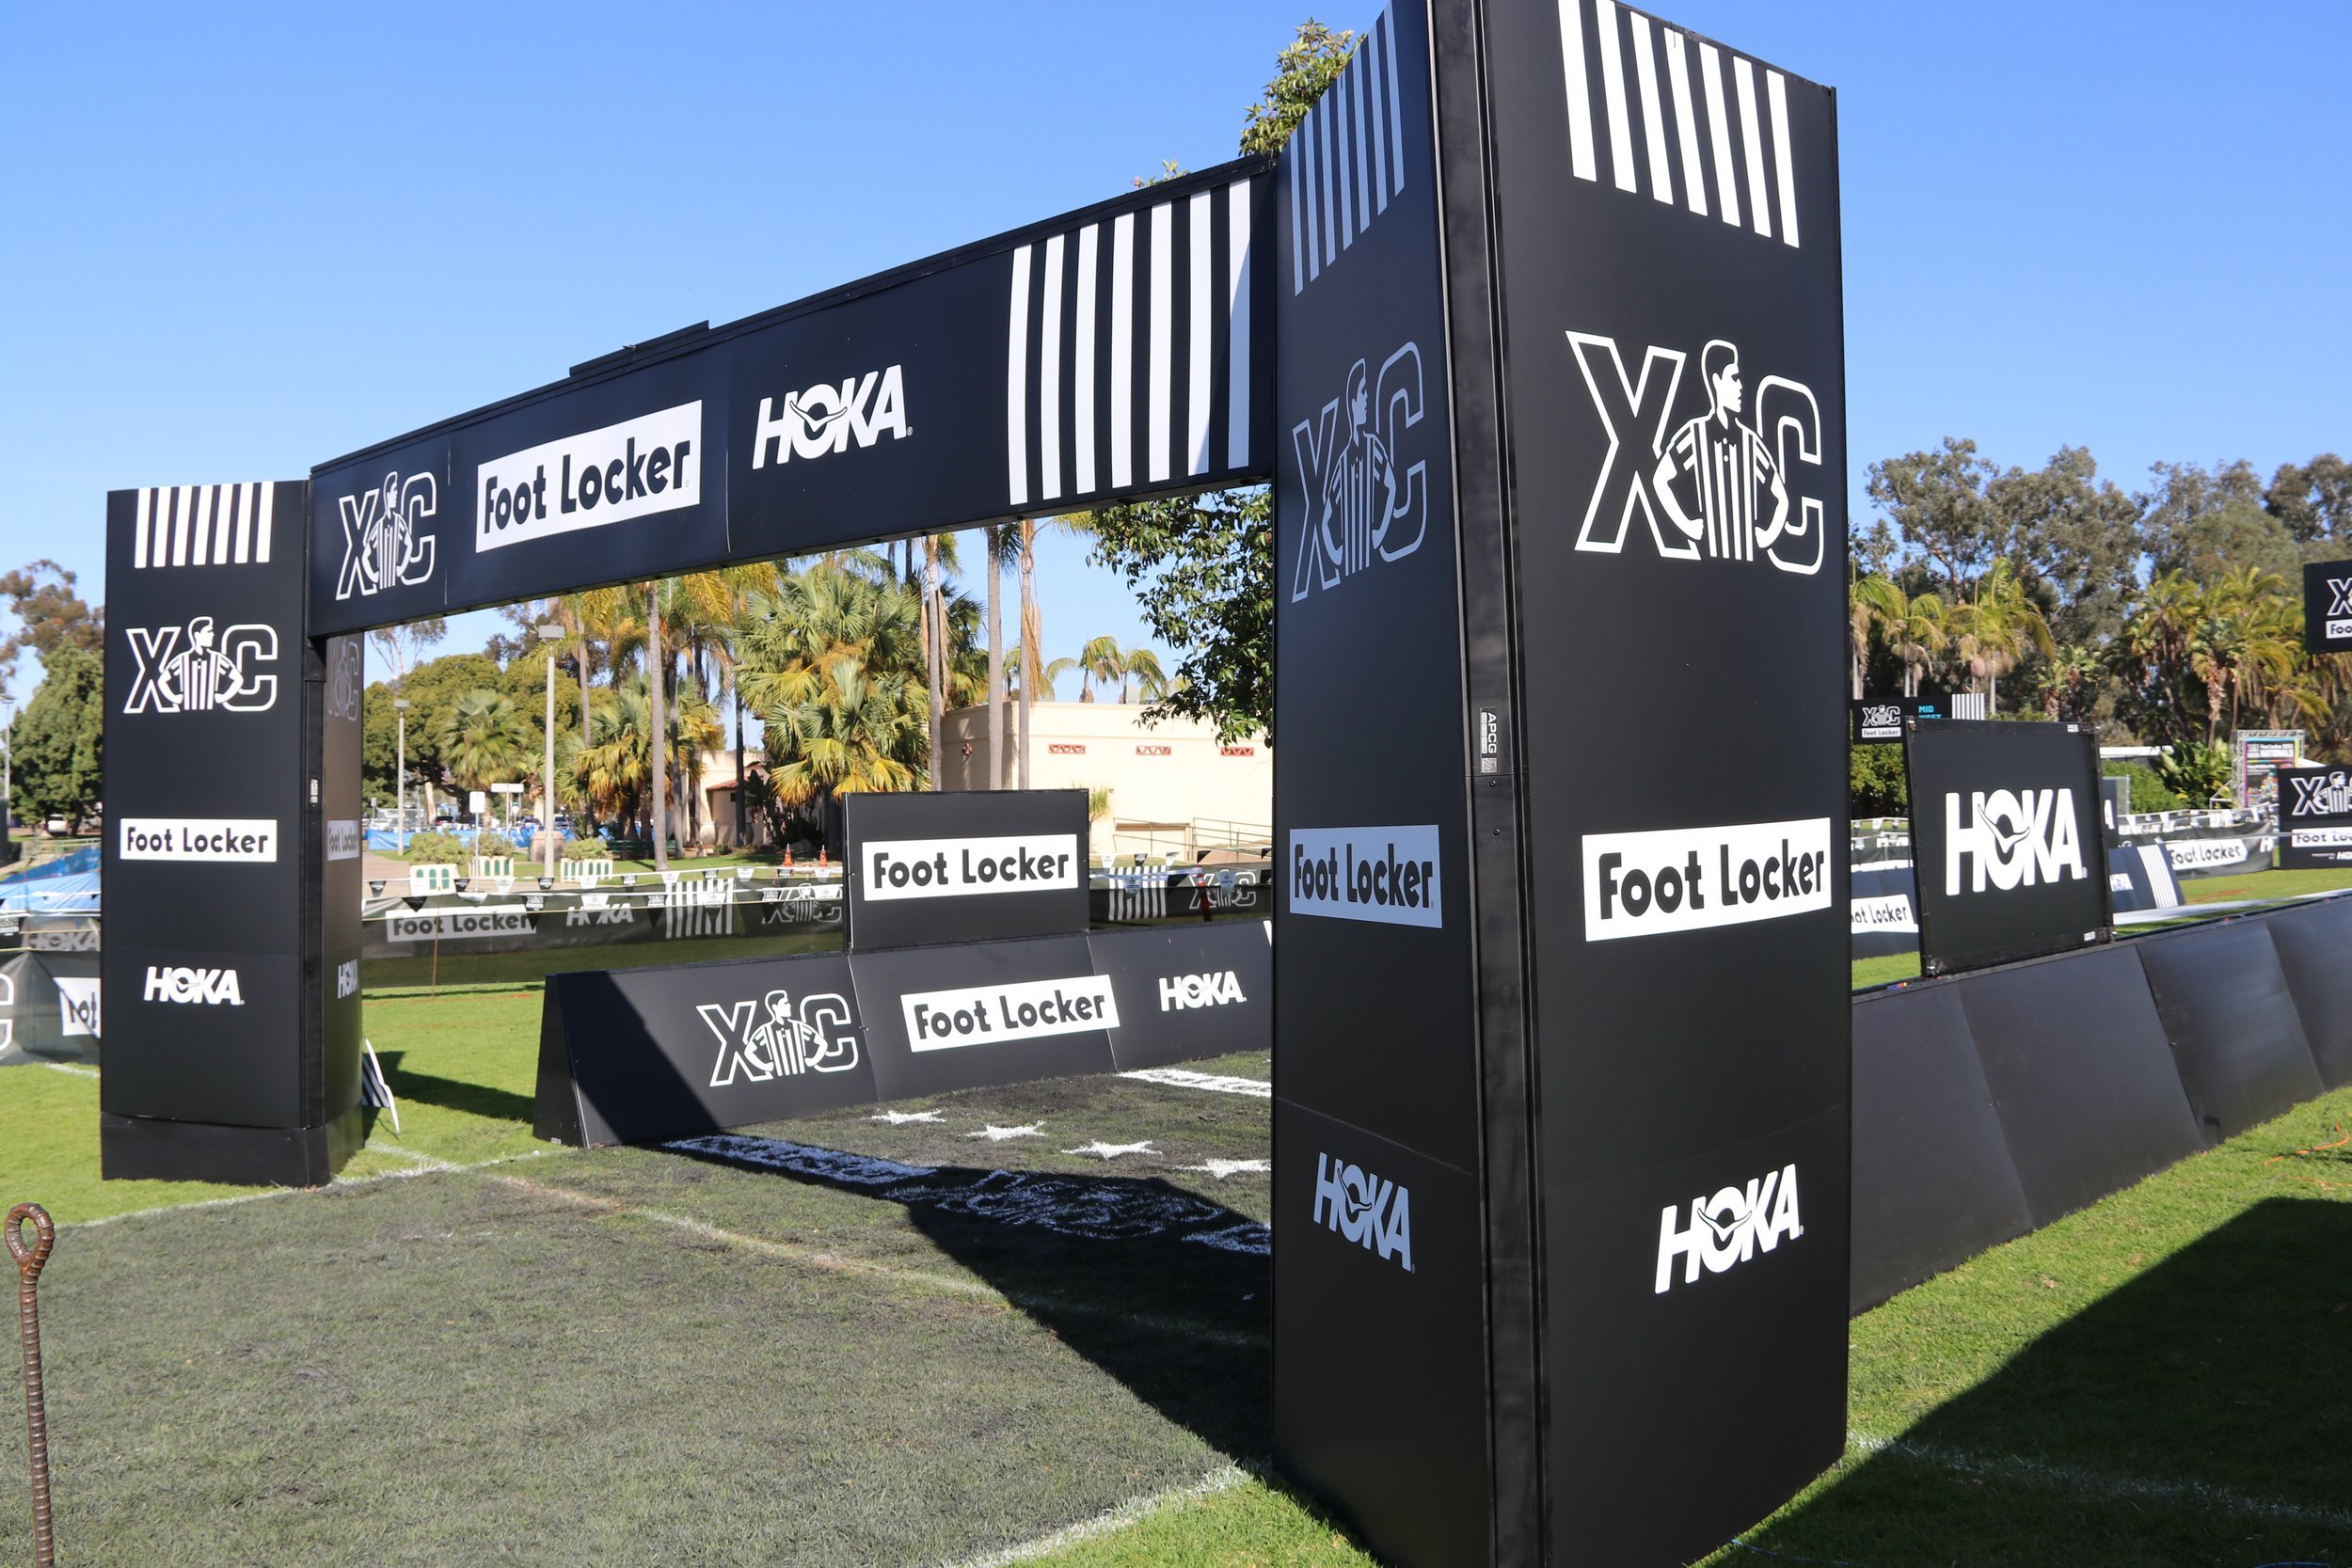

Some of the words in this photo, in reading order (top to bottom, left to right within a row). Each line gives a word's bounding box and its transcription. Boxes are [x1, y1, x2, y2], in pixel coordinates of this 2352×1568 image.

[753, 364, 911, 469] HOKA
[485, 465, 546, 533] Foot
[561, 437, 690, 514] Locker
[2330, 624, 2352, 635] Foo
[1487, 712, 1497, 753] APCG
[127, 826, 172, 852] Foot
[183, 828, 268, 853] Locker
[1946, 788, 2087, 896] HOKA
[2200, 846, 2242, 862] Locker
[874, 851, 947, 889] Foot
[962, 847, 1069, 883] Locker
[1295, 843, 1339, 901] Foot
[1346, 843, 1435, 910] Locker
[1599, 850, 1705, 920] Foot
[1721, 838, 1824, 907] Locker
[394, 916, 444, 936] Foot
[1868, 904, 1908, 924] Locker
[143, 966, 245, 1006] HOKA
[1159, 971, 1246, 1011] HOKA
[914, 1001, 991, 1039] Foot
[999, 990, 1106, 1030] Locker
[1313, 1152, 1414, 1273] HOKA
[1654, 1164, 1803, 1294] HOKA
